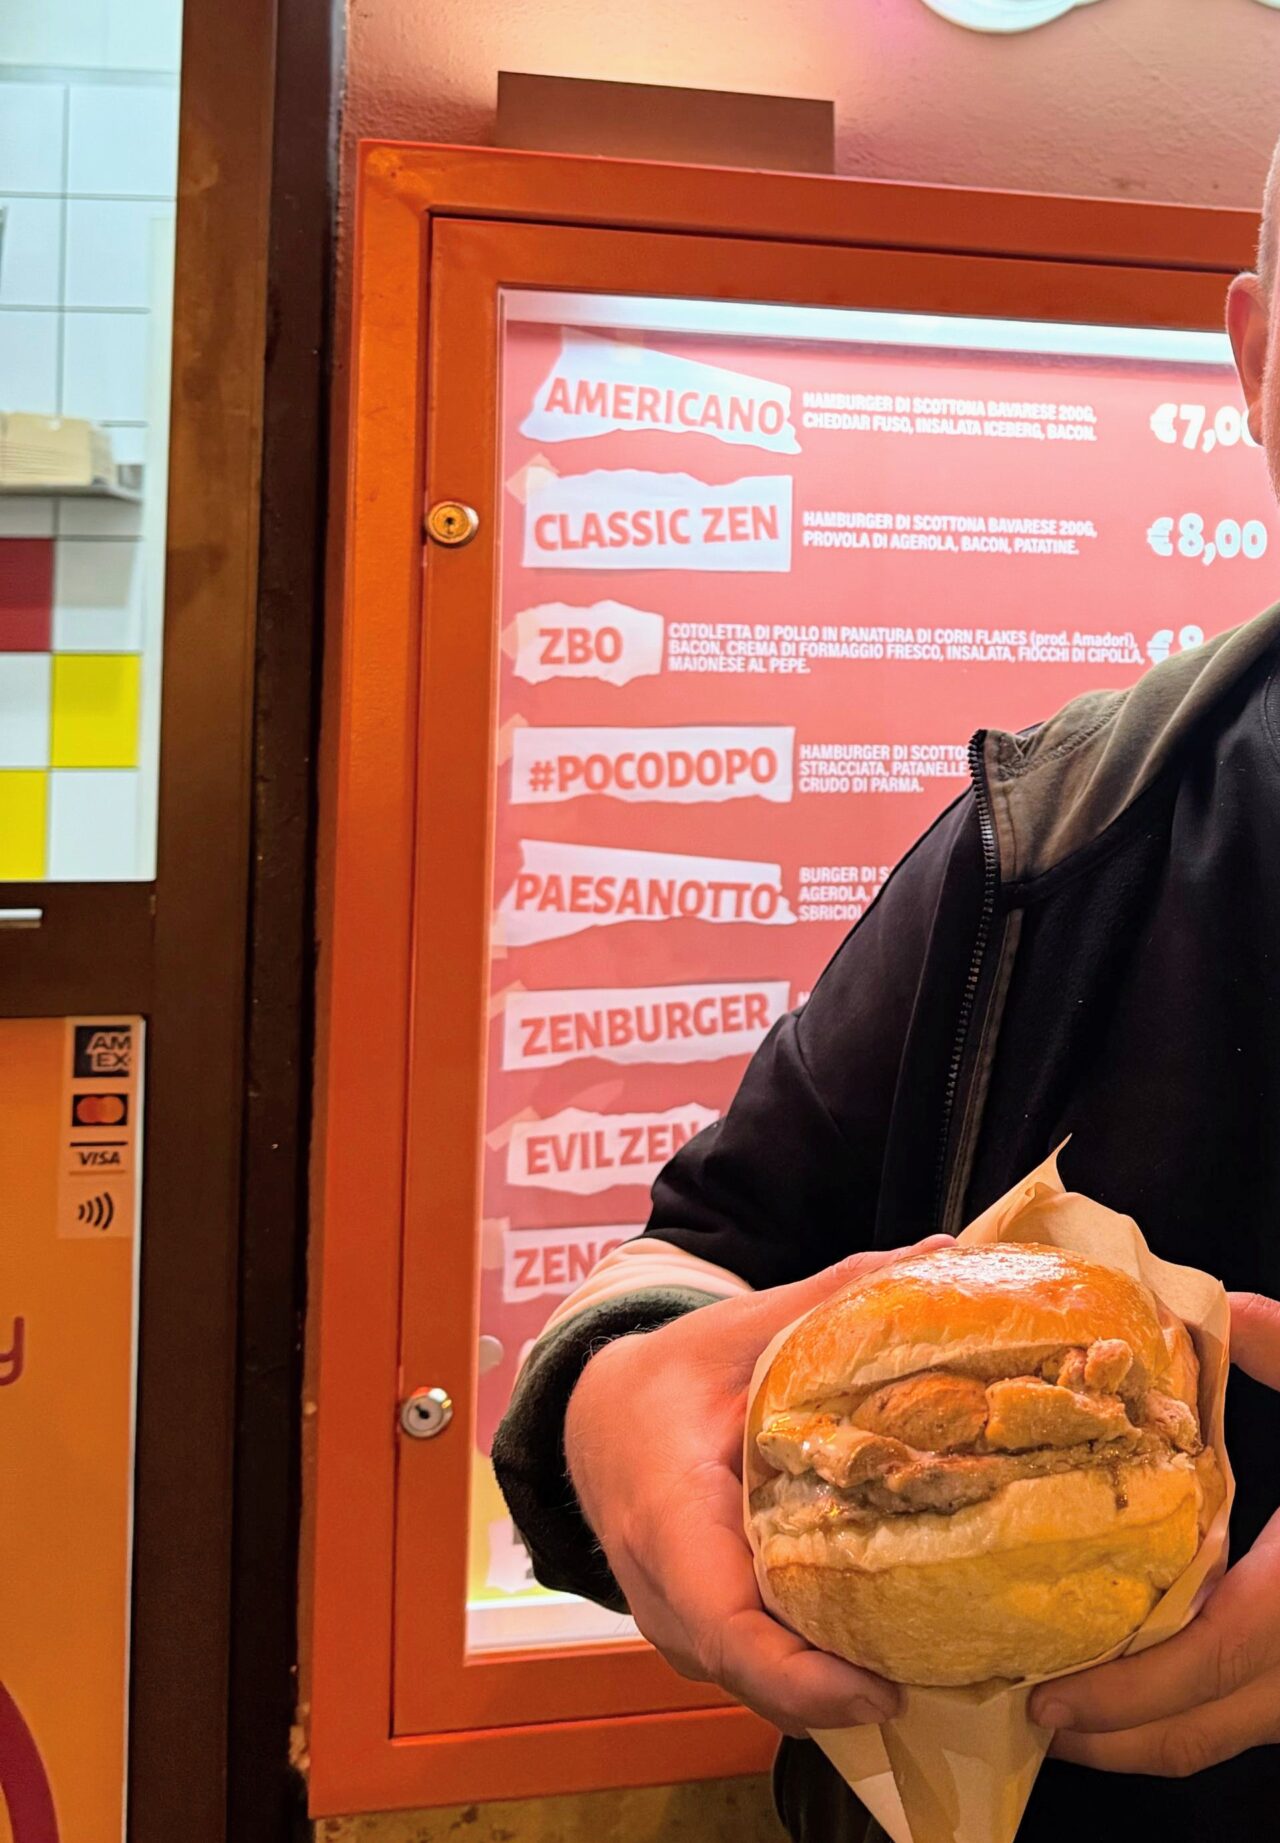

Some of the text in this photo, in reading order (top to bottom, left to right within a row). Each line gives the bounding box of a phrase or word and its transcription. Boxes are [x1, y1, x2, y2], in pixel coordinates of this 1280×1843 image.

[544, 377, 785, 435] AMERICANO
[803, 392, 893, 412] HAMBURGER
[895, 396, 911, 413] DI
[913, 397, 985, 416] SCOTTONA
[987, 400, 1057, 420] BAVARESE
[803, 412, 871, 430] CHEDDAR
[915, 417, 982, 435] INSALATA
[534, 505, 779, 551] CLASSIC ZEN
[803, 511, 893, 529] HAMBURGER
[895, 514, 911, 530] DI
[913, 515, 985, 533] SCOTTONA
[988, 517, 1058, 535] BAVARESE
[803, 530, 870, 548] PROVOLA
[872, 532, 888, 549] DI
[890, 534, 959, 553] AGEROLA,
[960, 535, 1012, 555] BACON,
[1147, 512, 1268, 566] €8,00
[669, 622, 752, 639] COTOLETTA
[754, 624, 770, 640] DI
[773, 625, 819, 641] POLLO
[822, 626, 837, 641] IN
[840, 626, 914, 643] PANATURA
[916, 628, 931, 644] DI
[934, 628, 973, 644] CORN
[975, 629, 1027, 645] FLAKES
[538, 626, 623, 667] ZBO
[726, 640, 778, 656] CREMA
[781, 641, 797, 657] DI
[800, 642, 883, 659] FORMAGGIO
[886, 643, 944, 662] FRESCO,
[946, 645, 1016, 663] INSALATA,
[1018, 646, 1069, 662] FIOCCHI
[1071, 647, 1085, 662] DI
[1087, 647, 1145, 665] CIPOLLA,
[669, 656, 811, 674] MAIONESE AL PEPE.
[800, 744, 890, 761] HAMBURGER
[892, 744, 908, 760] DI
[529, 746, 778, 793] #POCODOPO
[800, 760, 968, 777] STRACCIATA, PATANELLE
[800, 776, 924, 793] CRUDO DI PARMA.
[799, 866, 859, 883] BURGER
[861, 866, 877, 883] DI
[514, 872, 780, 920] PAESANOTTO
[520, 992, 771, 1057] ZENBURGER
[78, 1151, 121, 1166] VISA
